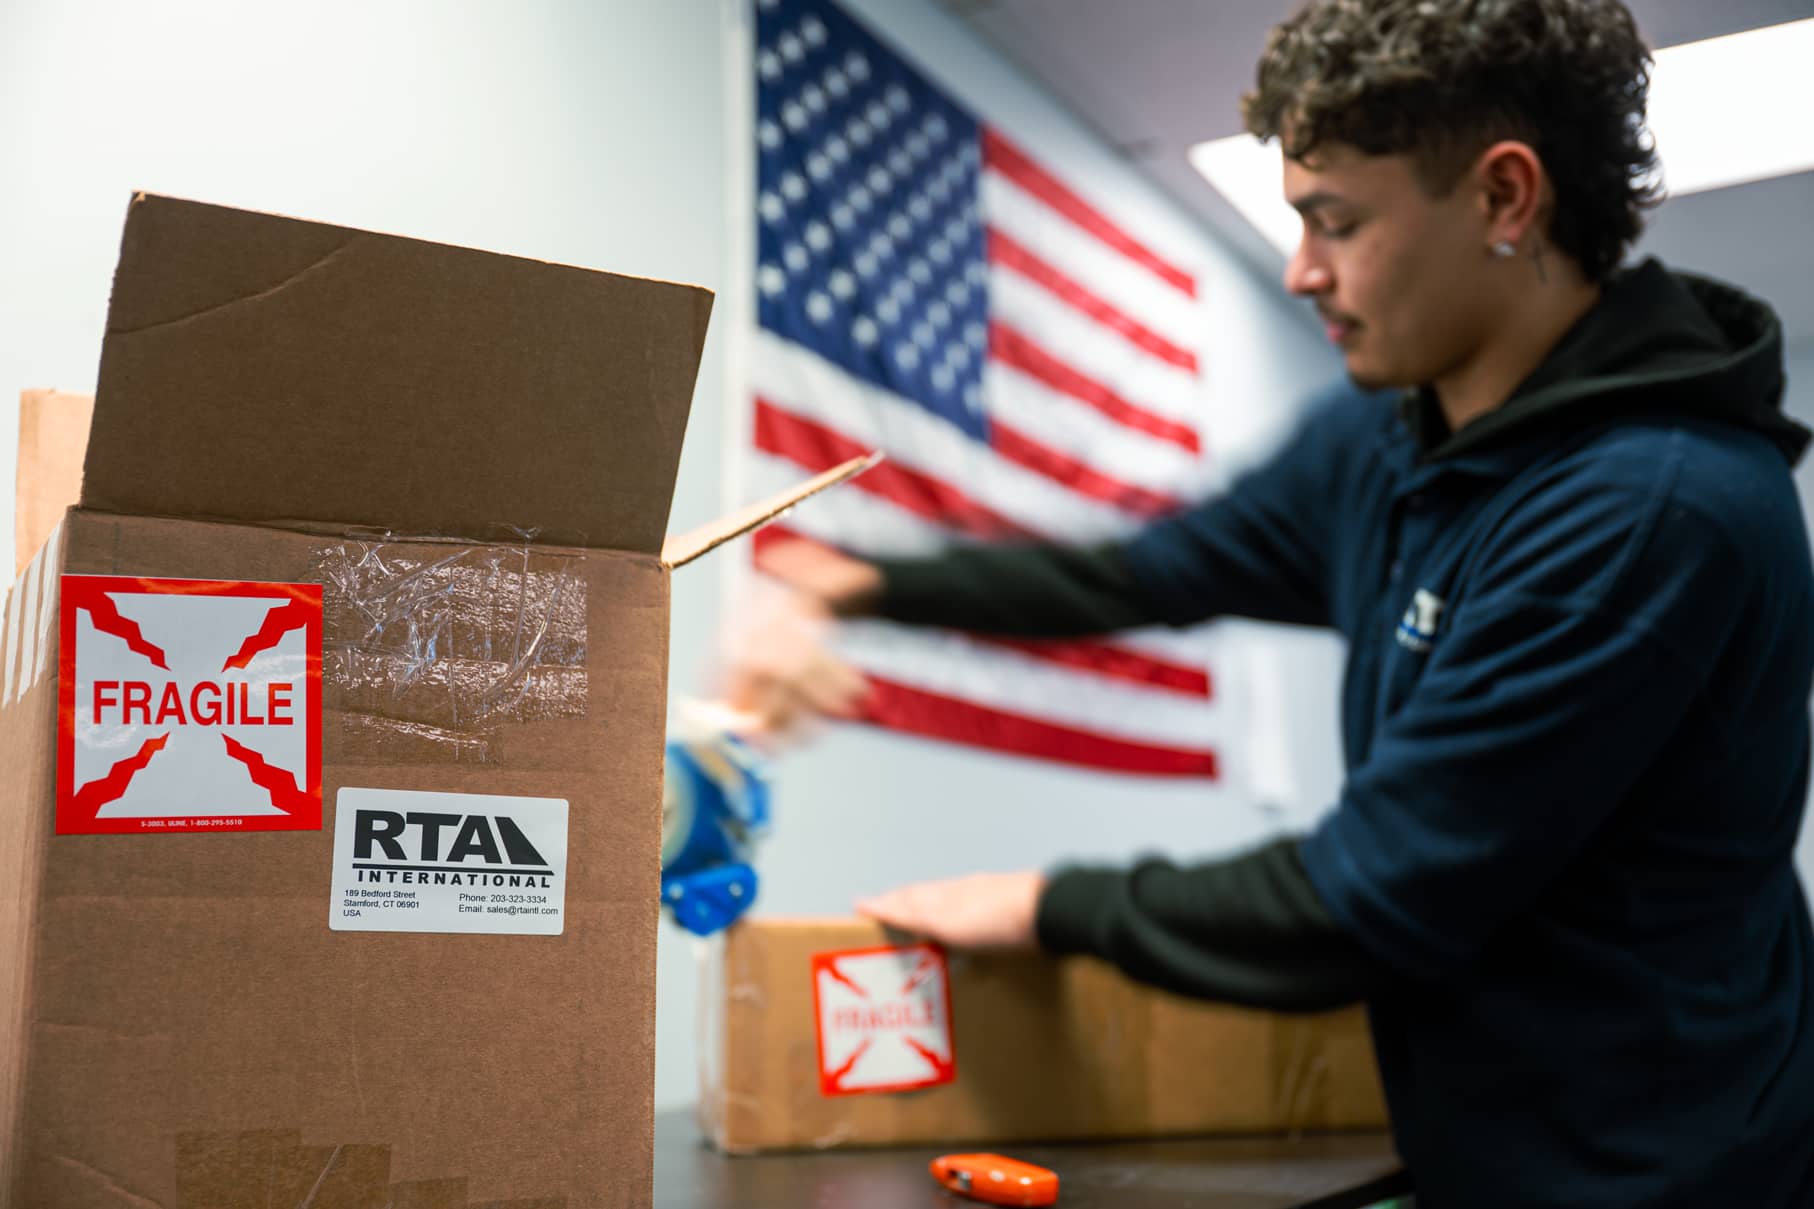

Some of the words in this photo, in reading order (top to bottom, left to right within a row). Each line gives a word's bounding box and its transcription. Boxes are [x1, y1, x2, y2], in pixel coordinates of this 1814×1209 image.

[93, 680, 294, 726] FRAGILE
[358, 870, 550, 888] INTERNATIONAL
[345, 889, 359, 897] 189
[361, 890, 391, 898] Bedford
[393, 890, 416, 899] Street
[459, 893, 487, 902] Phone:
[490, 894, 547, 904] 203-323-3334
[343, 899, 381, 908] Stamford,
[383, 900, 394, 908] CT
[396, 900, 420, 909] 06901
[458, 904, 484, 913] Email:
[486, 905, 559, 915] sales@rtaintl.com
[343, 909, 361, 917] USA
